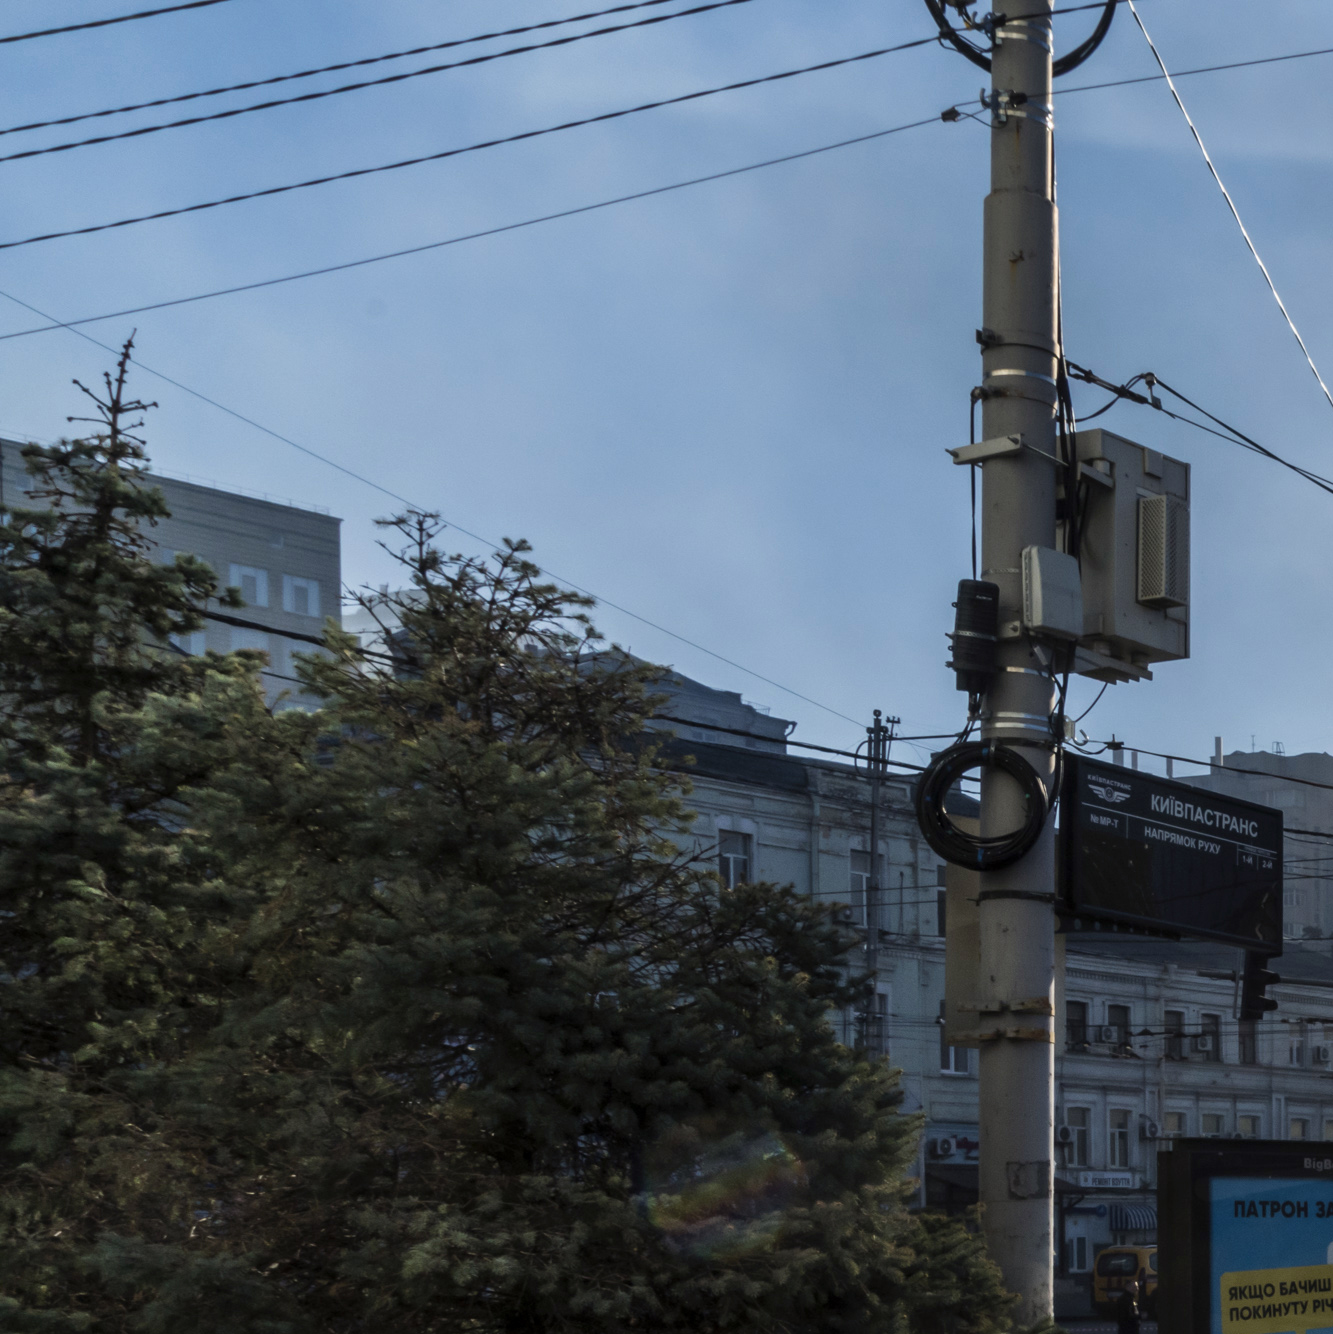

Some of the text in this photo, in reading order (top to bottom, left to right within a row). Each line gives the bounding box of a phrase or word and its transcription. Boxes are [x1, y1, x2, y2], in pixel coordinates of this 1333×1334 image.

[1087, 774, 1132, 791] КИЇВПАСТРАНС
[1150, 793, 1258, 838] КИЇВПАСТРАНС
[1144, 826, 1196, 849] НАПРЯМОК
[1198, 839, 1221, 855] РУХУ
[1234, 1200, 1308, 1218] ПАТРОН
[1229, 1278, 1331, 1301] ЯКЩО БАЧИШ
[1229, 1300, 1308, 1322] ПОКИНУТУ
